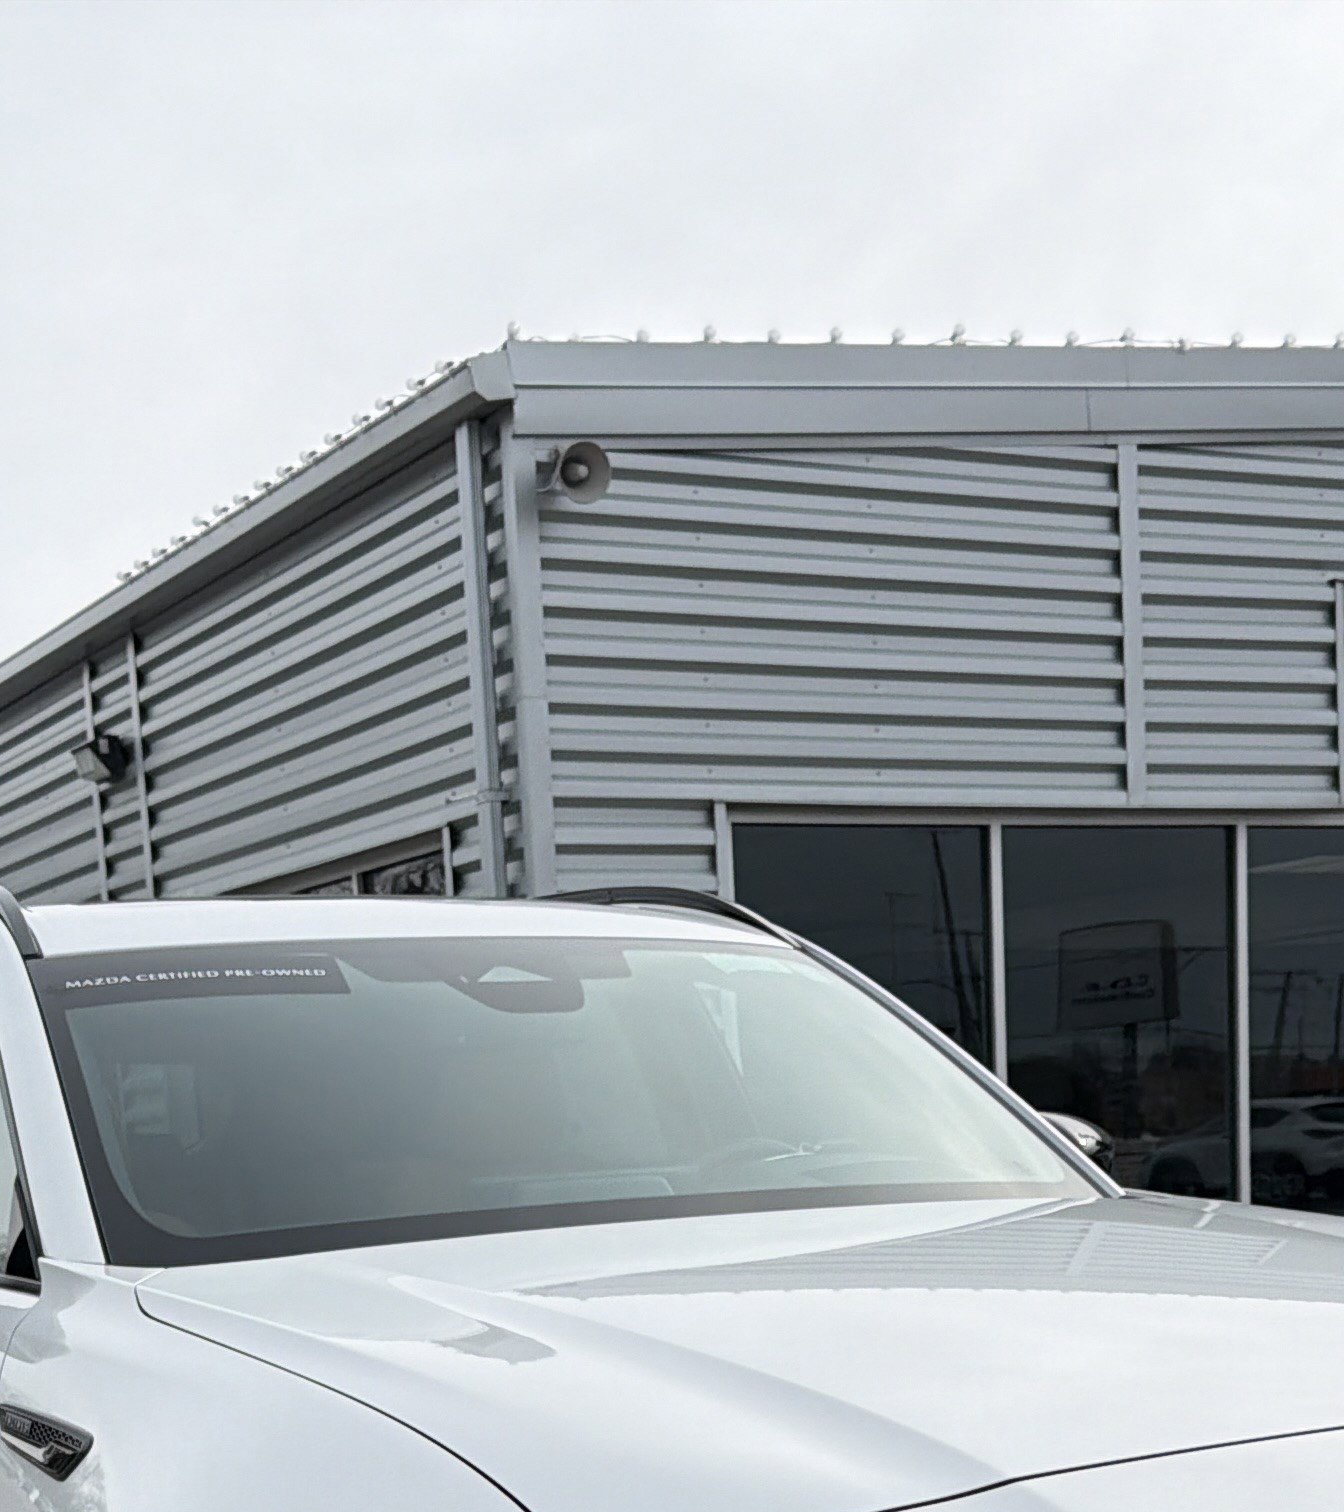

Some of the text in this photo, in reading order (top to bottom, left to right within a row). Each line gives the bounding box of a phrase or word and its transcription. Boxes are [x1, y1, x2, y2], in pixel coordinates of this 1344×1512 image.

[64, 967, 328, 990] MAZDA CERTIFIED PRE-OWNED
